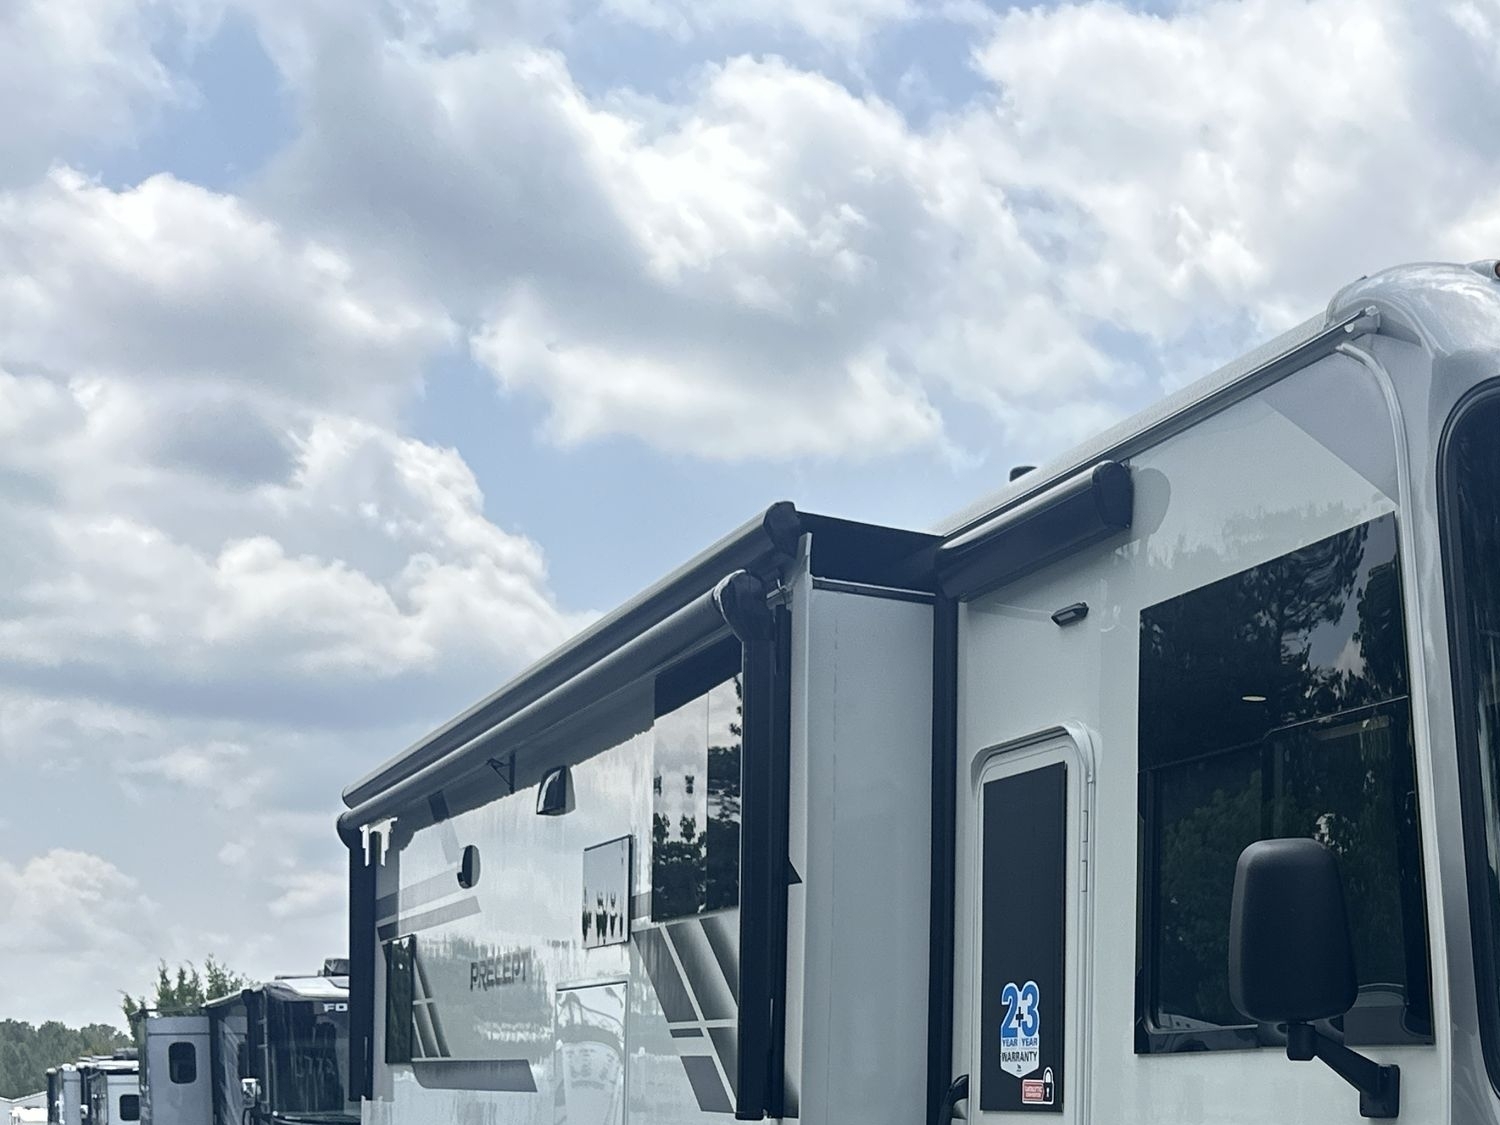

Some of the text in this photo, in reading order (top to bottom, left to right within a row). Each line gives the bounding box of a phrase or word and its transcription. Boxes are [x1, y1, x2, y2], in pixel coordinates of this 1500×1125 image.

[470, 951, 529, 992] PRECEPT
[1002, 1038, 1038, 1047] YEAR YEAR
[1001, 1051, 1038, 1062] WARRANTY
